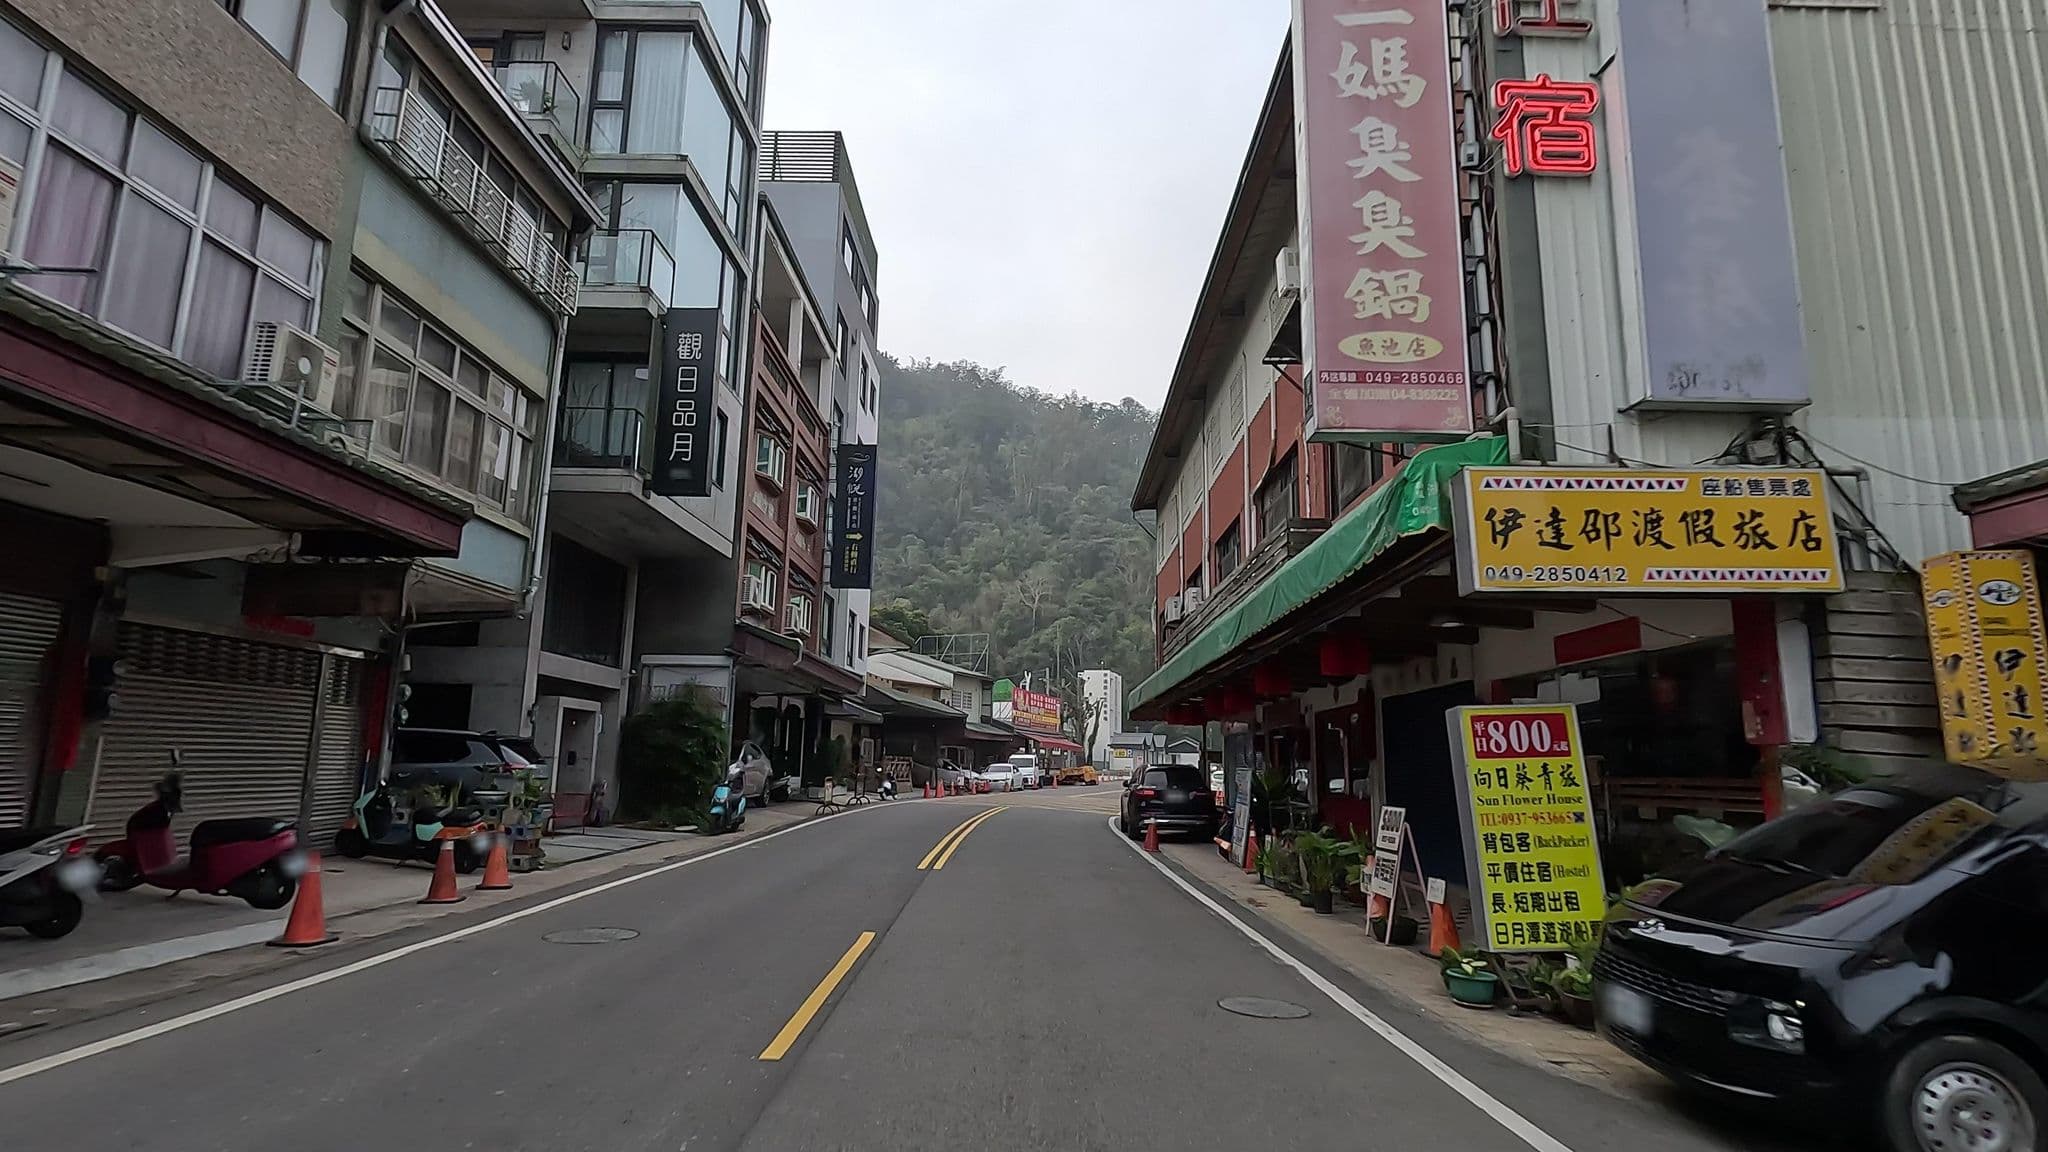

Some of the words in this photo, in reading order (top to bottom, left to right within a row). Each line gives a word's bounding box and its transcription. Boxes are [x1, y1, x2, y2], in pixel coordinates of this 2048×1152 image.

[1357, 337, 1426, 358] 魚池店
[1365, 372, 1464, 384] 049-2850468
[669, 332, 702, 461] 觀日品月
[1702, 478, 1813, 497] 座船售票處
[1484, 506, 1823, 552] 伊達邵渡假旅店
[1484, 566, 1628, 582] 049-2850412
[1473, 721, 1488, 752] 平日
[1487, 719, 1552, 754] 800
[1474, 762, 1581, 791] 向日葵青旅
[1477, 795, 1500, 806] Sun
[1502, 794, 1543, 806] Flower
[1546, 793, 1584, 805] House
[1482, 832, 1532, 854] 背包客
[1486, 861, 1552, 883] 平價住宿
[1553, 864, 1590, 879] (Hostel)
